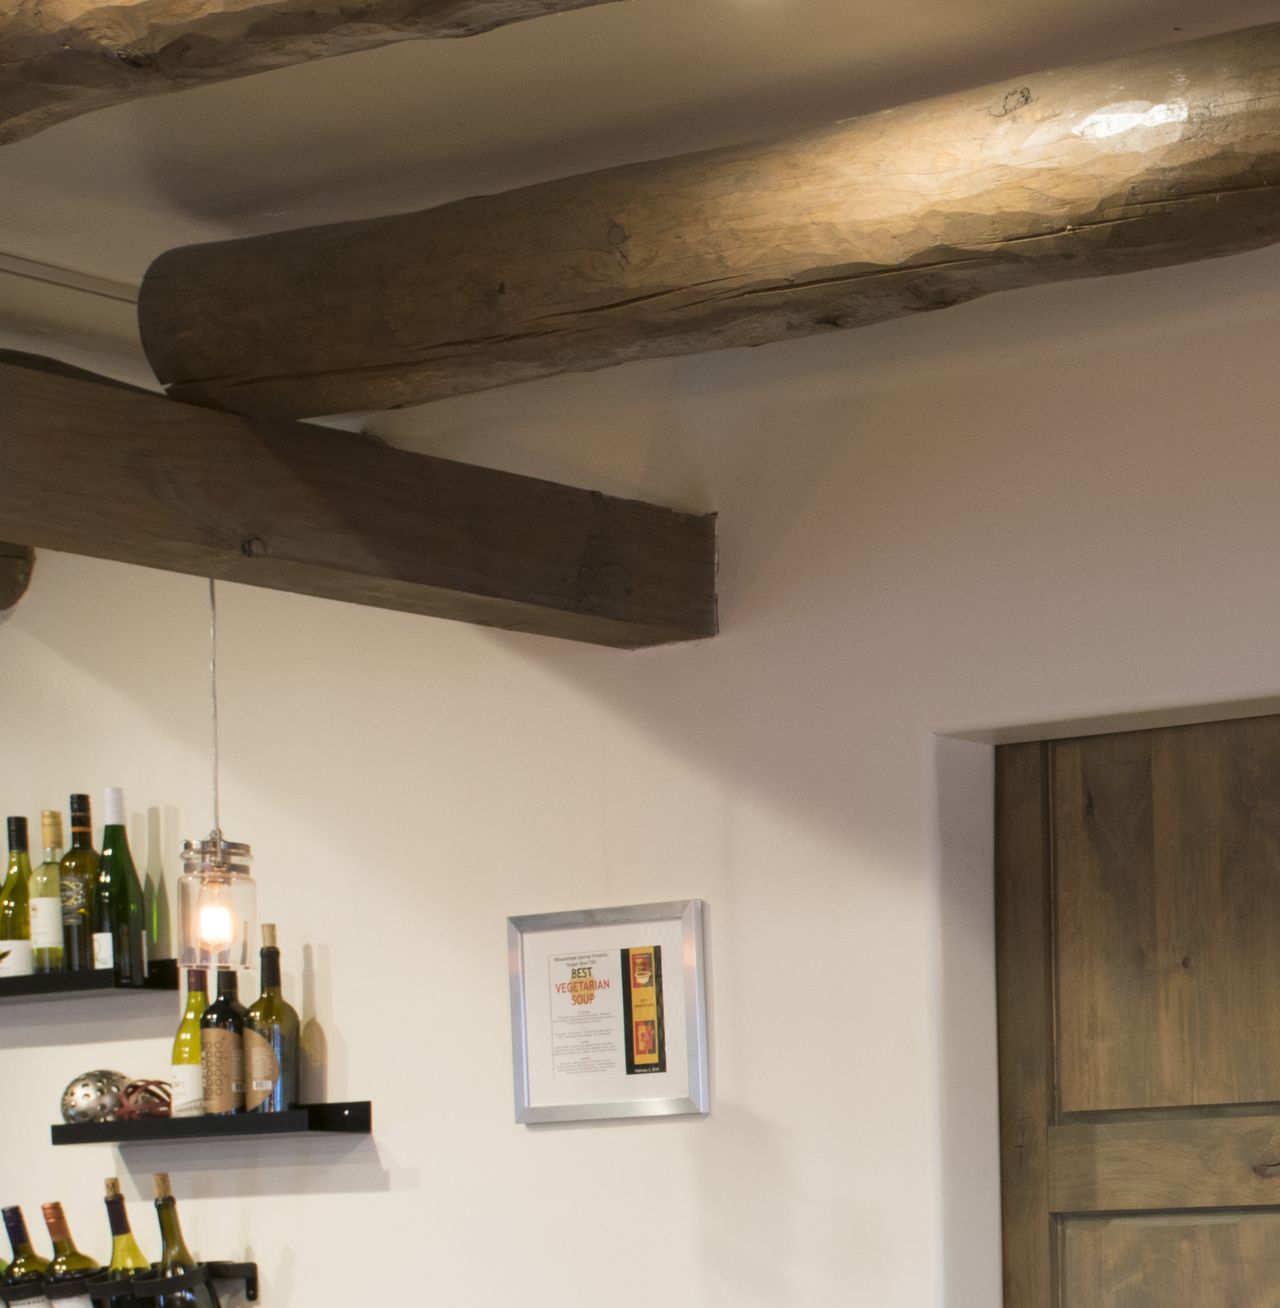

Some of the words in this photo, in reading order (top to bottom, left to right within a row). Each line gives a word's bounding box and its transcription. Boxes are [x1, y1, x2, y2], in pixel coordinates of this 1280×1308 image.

[571, 967, 592, 979] BEST
[555, 979, 610, 993] VEGETARIAN
[571, 994, 595, 1005] SOUP
